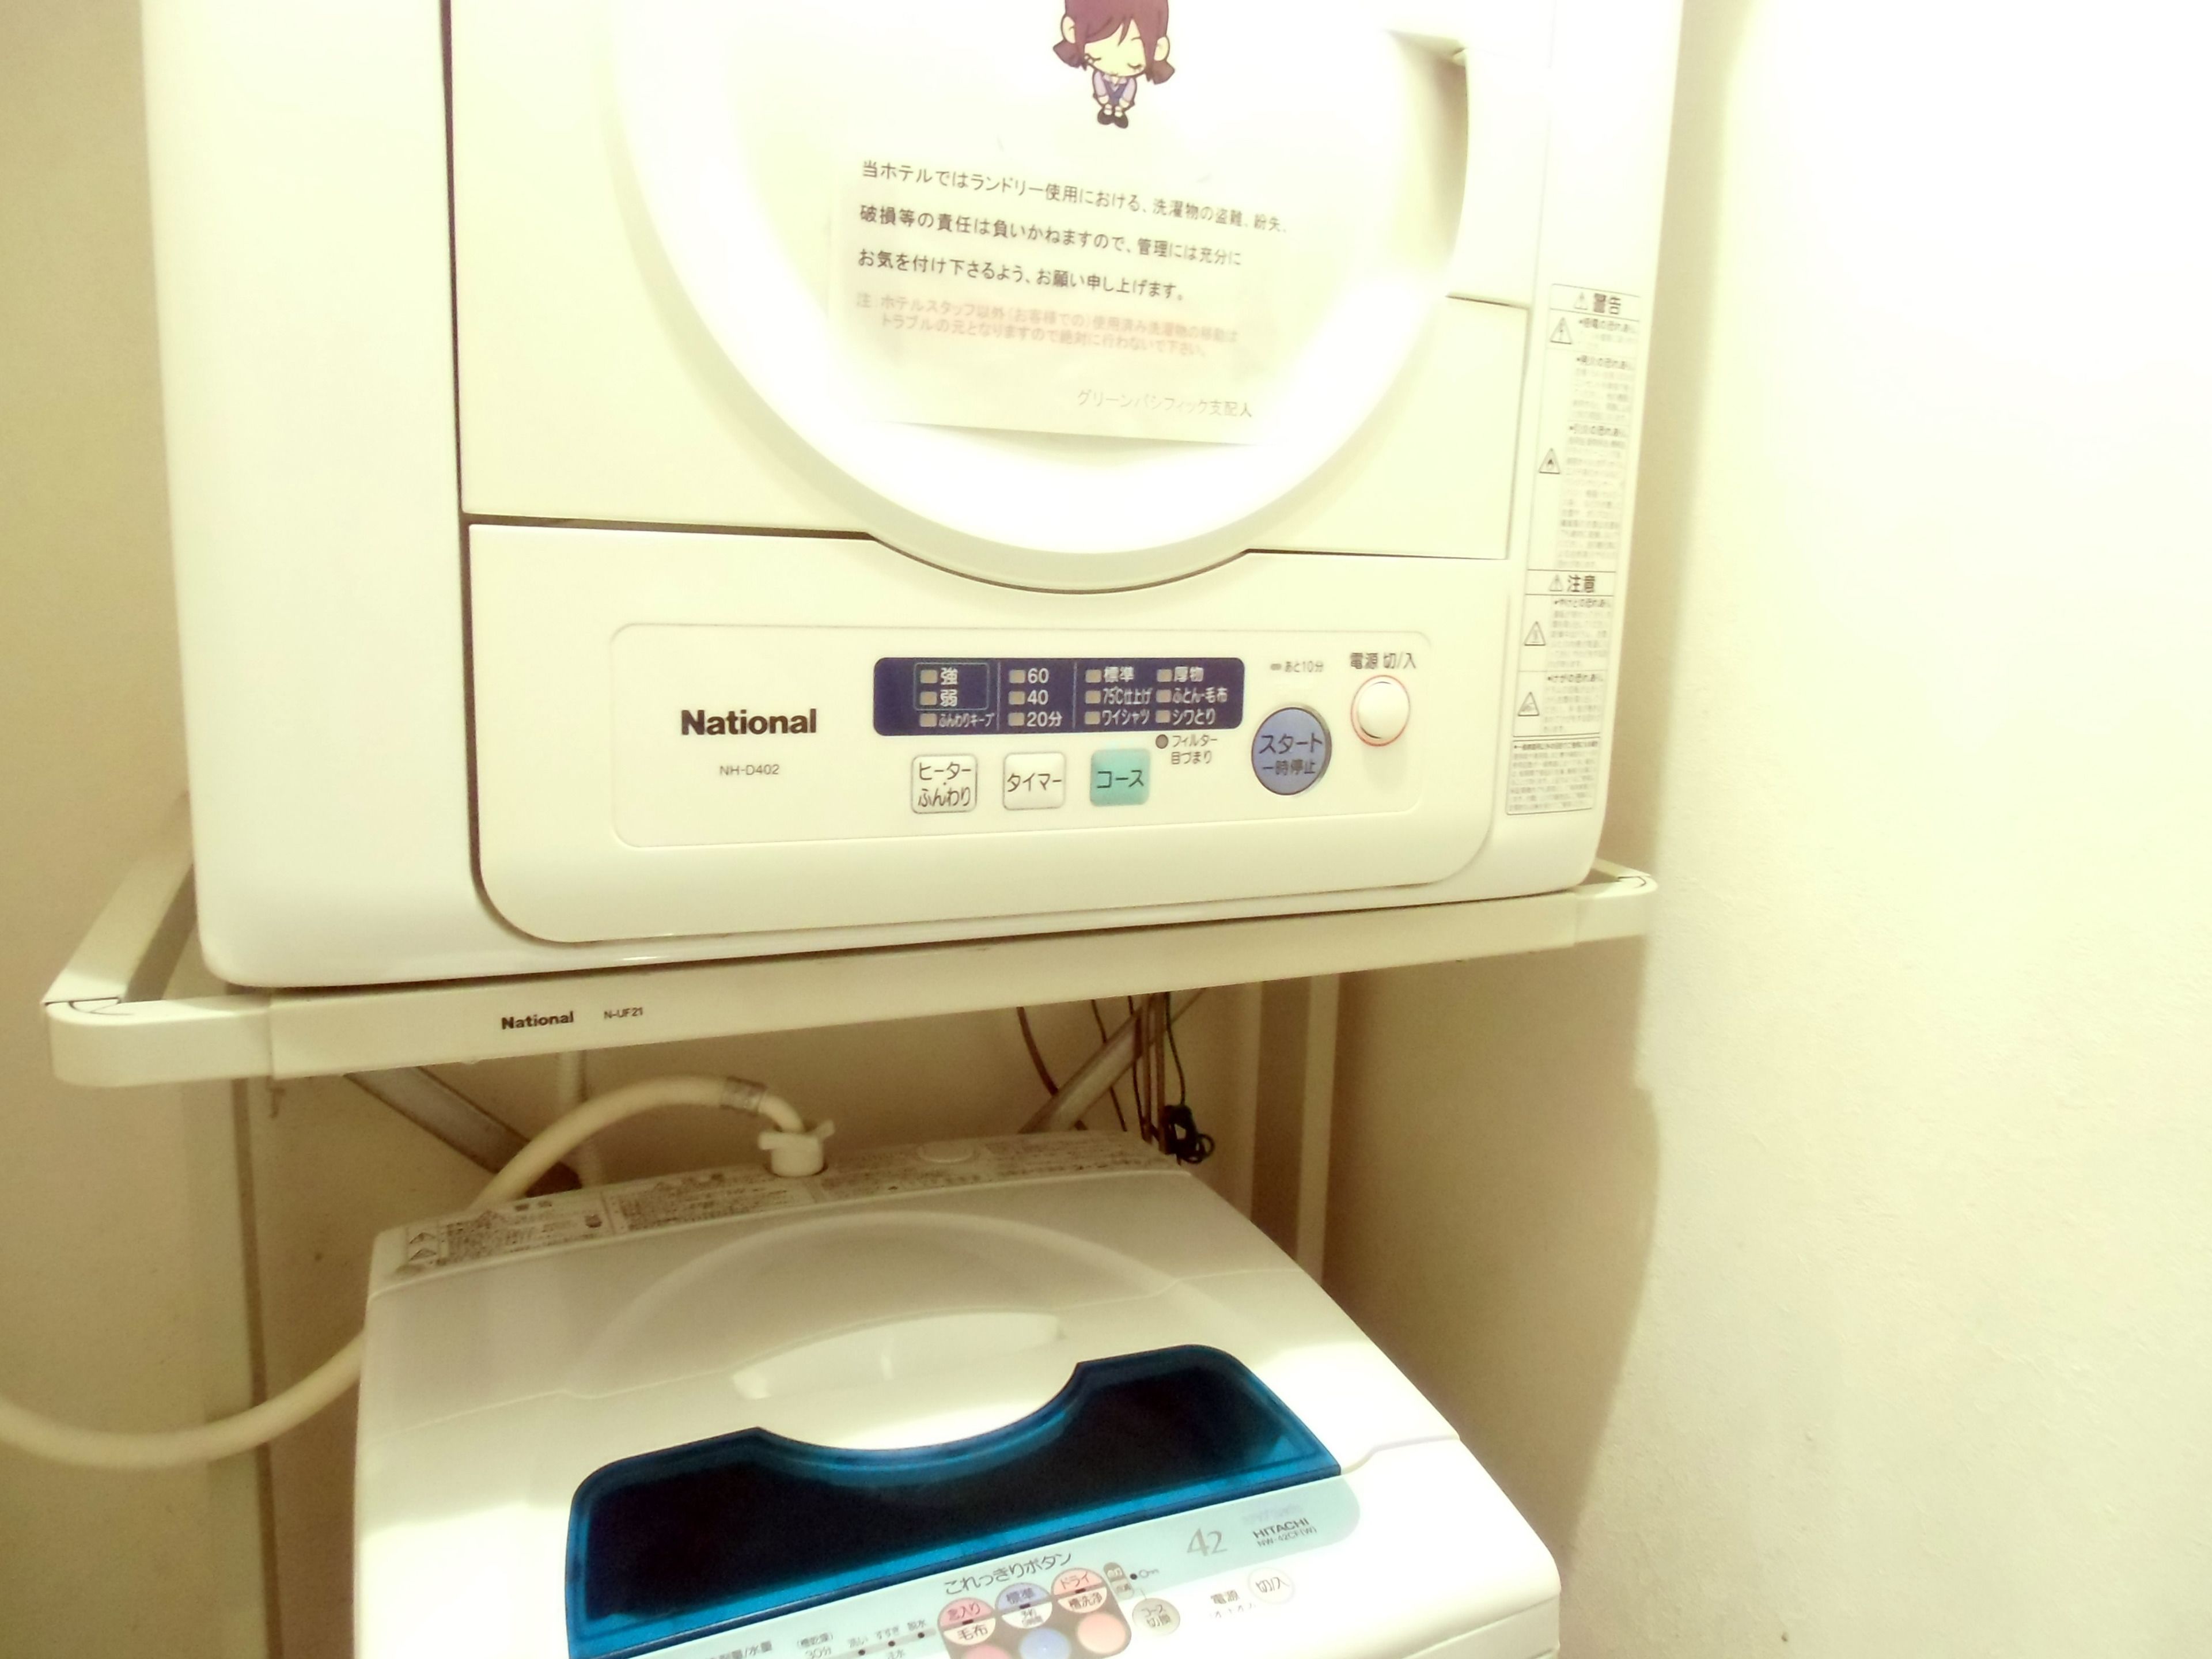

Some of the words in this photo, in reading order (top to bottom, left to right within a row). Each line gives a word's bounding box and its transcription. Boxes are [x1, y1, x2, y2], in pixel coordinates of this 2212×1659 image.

[1567, 574, 1595, 593] 注意
[941, 667, 958, 685] 強
[1028, 668, 1049, 684] 60
[940, 689, 958, 707] 弱
[1027, 690, 1048, 705] 40
[681, 708, 817, 735] National
[1027, 711, 1063, 727] 20分
[1102, 709, 1150, 726] ワイシャツ
[1173, 708, 1216, 726] シワとり
[1172, 734, 1218, 748] フィルター
[1259, 732, 1323, 755] スタート
[1171, 750, 1212, 765] 目づまり
[719, 764, 779, 775] NH-D402
[919, 762, 972, 781] ヒーター
[1097, 769, 1145, 789] コース
[1007, 772, 1062, 792] タイマー
[918, 787, 971, 807] ふんわり
[502, 1010, 574, 1030] National
[604, 1007, 643, 1019] N-UF21
[1252, 1517, 1309, 1539] HITACHI
[1187, 1528, 1228, 1556] 42
[945, 1552, 1072, 1595] これっきりボタン
[1060, 1571, 1089, 1590] ドライ
[958, 1623, 988, 1641] 毛布
